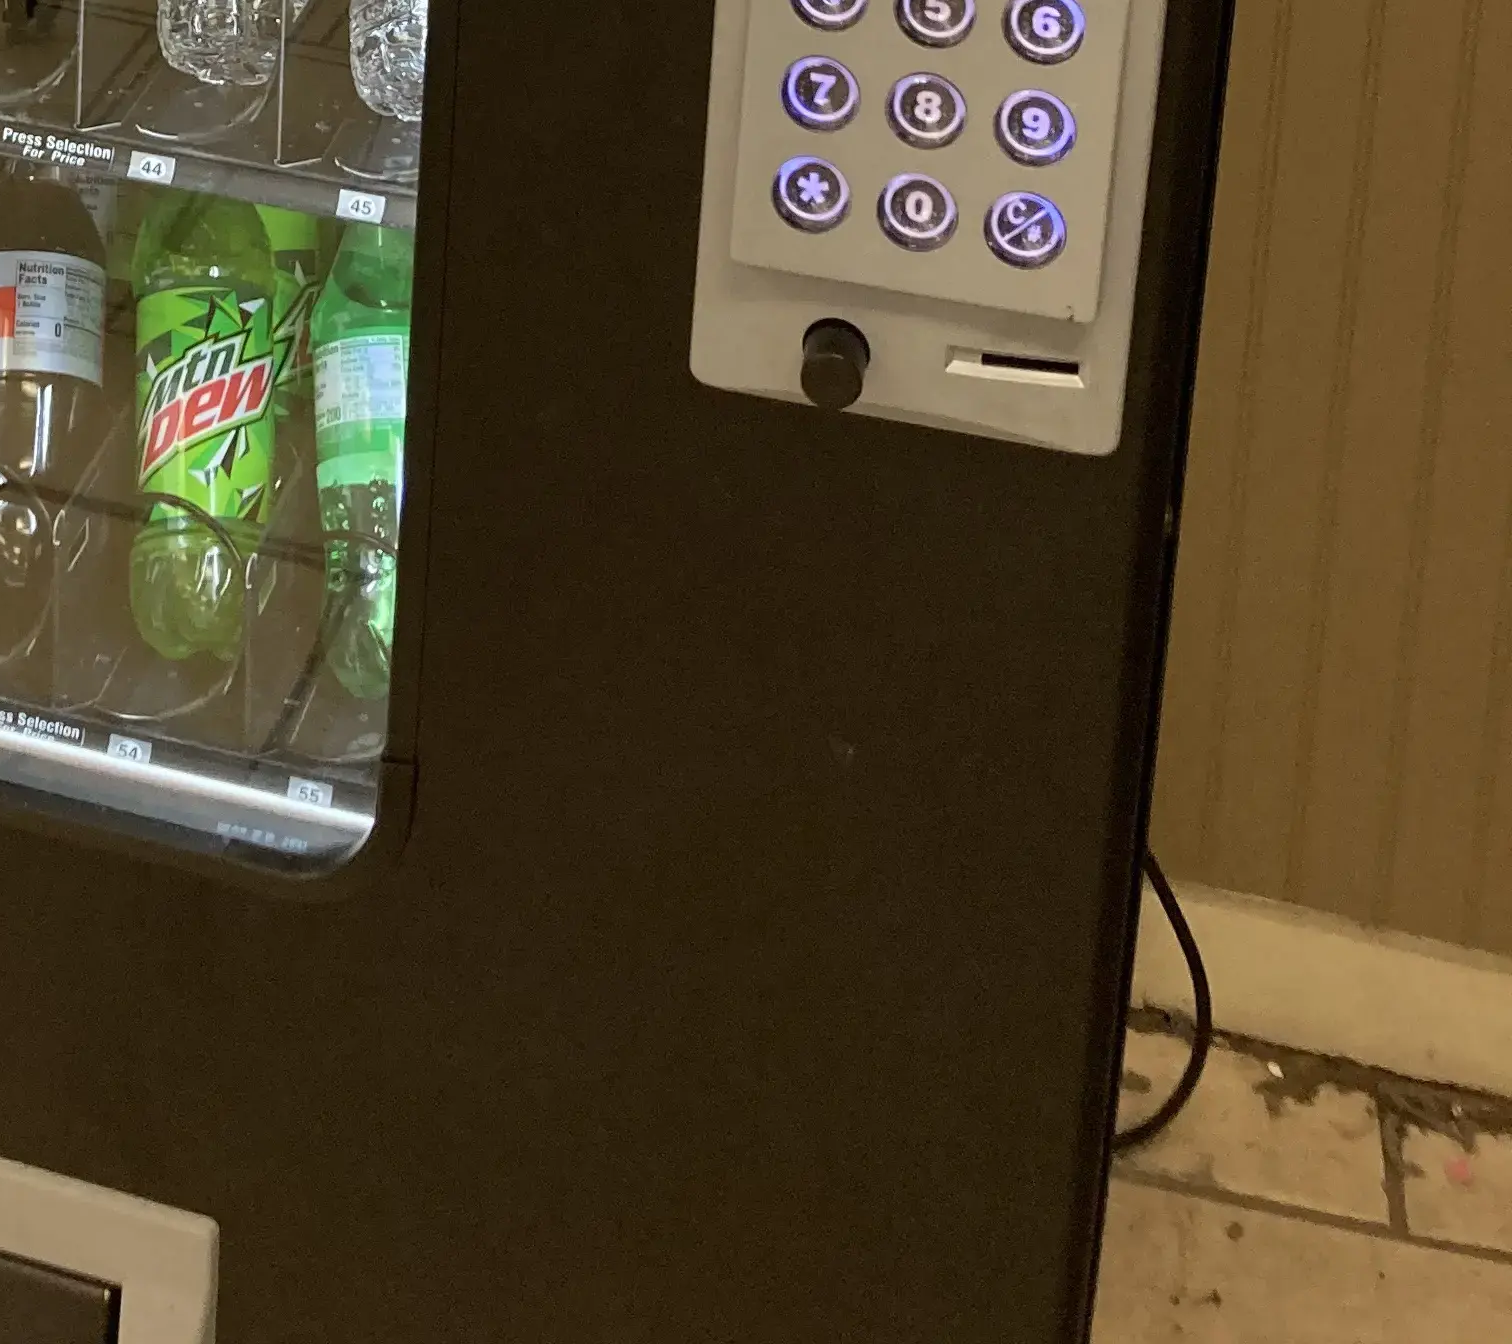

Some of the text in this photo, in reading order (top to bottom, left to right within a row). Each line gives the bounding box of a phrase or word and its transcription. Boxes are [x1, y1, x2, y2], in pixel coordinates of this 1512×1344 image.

[1032, 6, 1062, 38] 6
[810, 73, 836, 106] 7
[914, 90, 941, 123] 8
[1021, 107, 1050, 140] 9
[2, 126, 112, 159] Press Selection
[22, 145, 85, 167] For Price
[142, 160, 163, 175] 44
[351, 199, 372, 214] 45
[906, 191, 932, 222] 0
[18, 273, 48, 285] Facts
[19, 261, 64, 276] Nutrition
[18, 712, 80, 740] Selection
[118, 744, 138, 760] 54
[299, 787, 319, 802] 55
